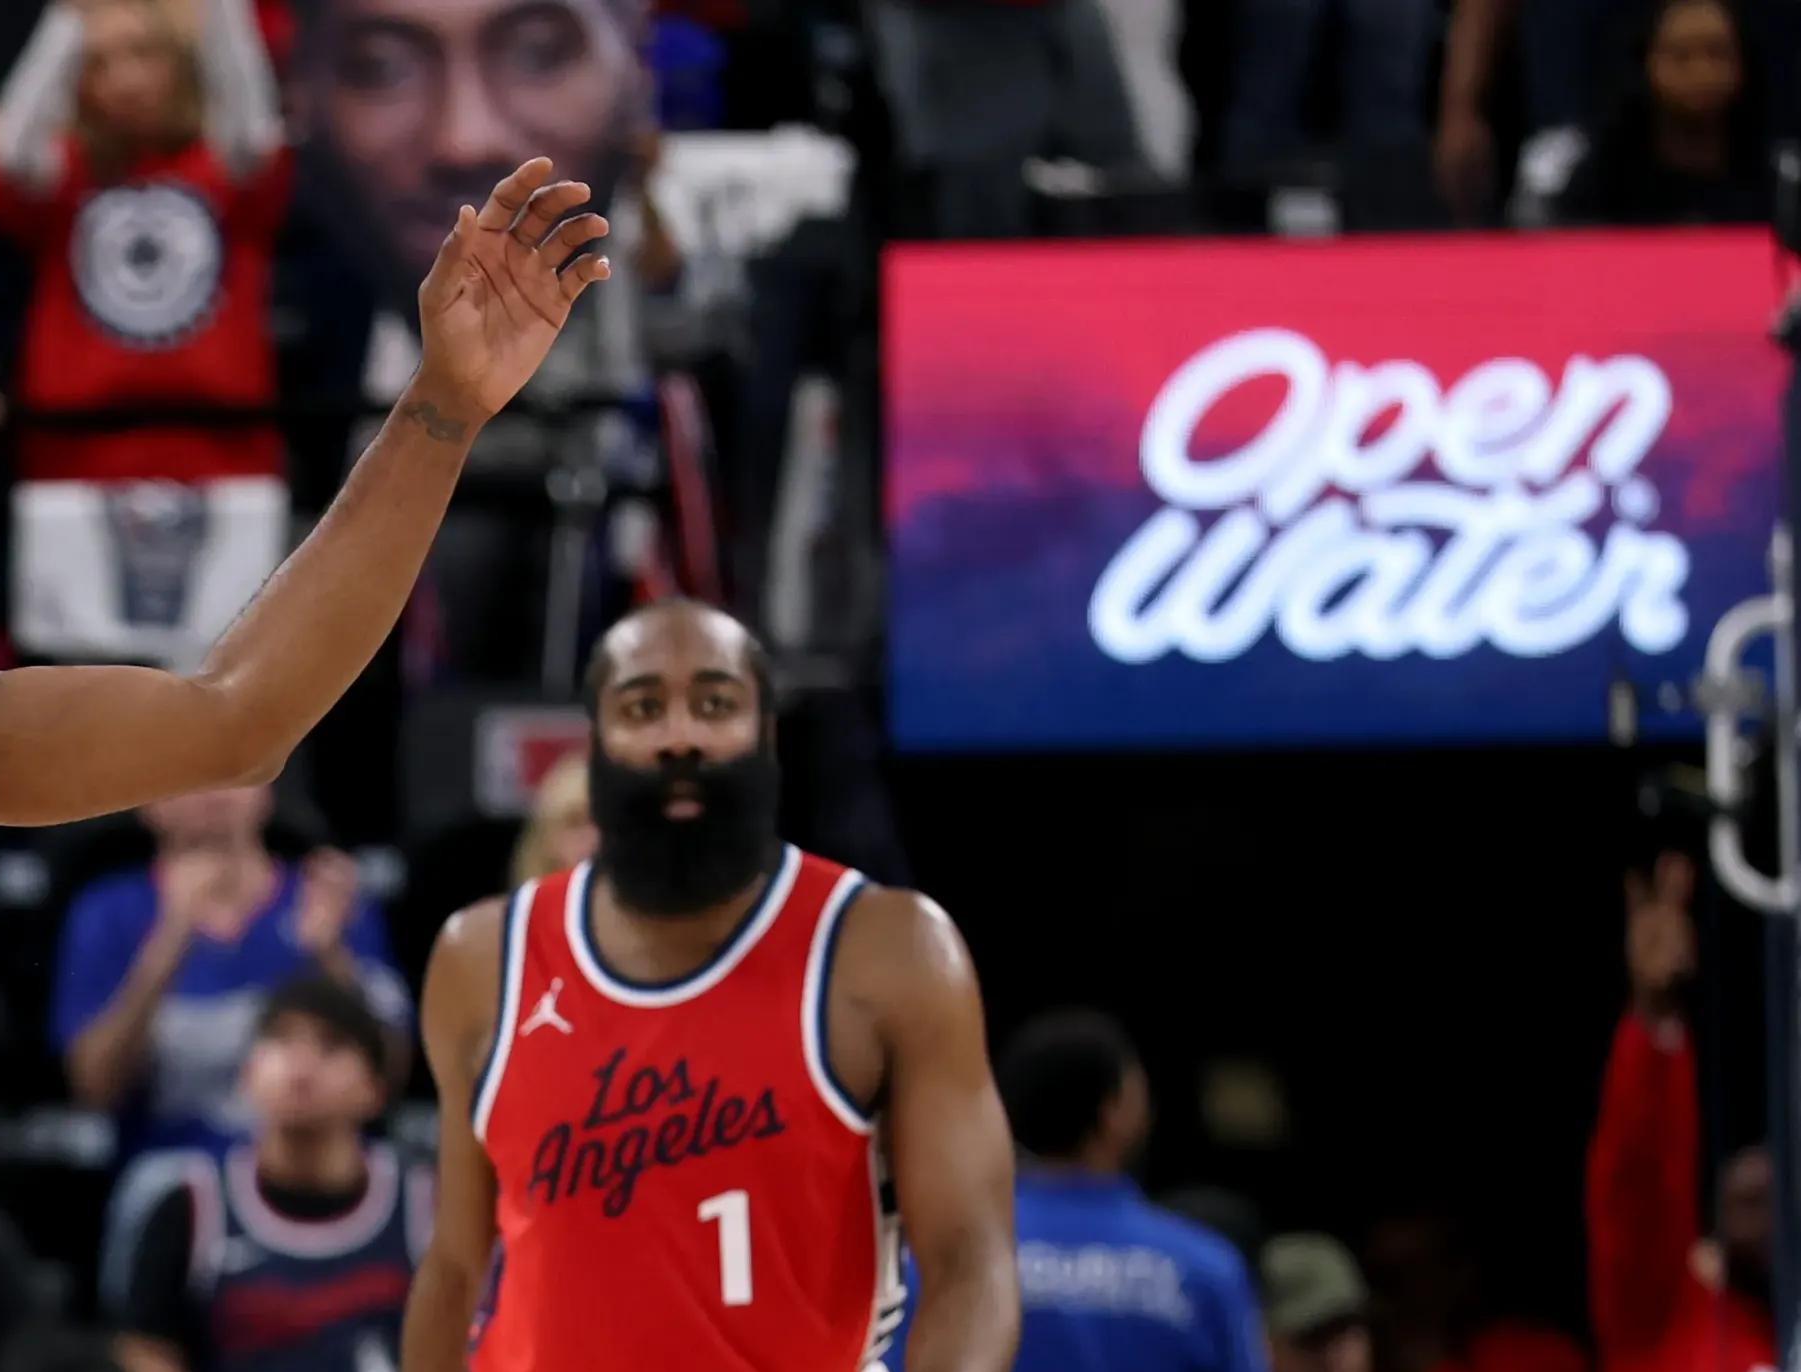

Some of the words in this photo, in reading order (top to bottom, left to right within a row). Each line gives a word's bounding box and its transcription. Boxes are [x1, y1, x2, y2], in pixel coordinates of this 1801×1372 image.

[1141, 328, 1671, 523] Open
[1088, 476, 1688, 663] Water
[526, 1084, 786, 1217] Angeles
[581, 1046, 695, 1131] Los
[697, 1189, 753, 1306] 1
